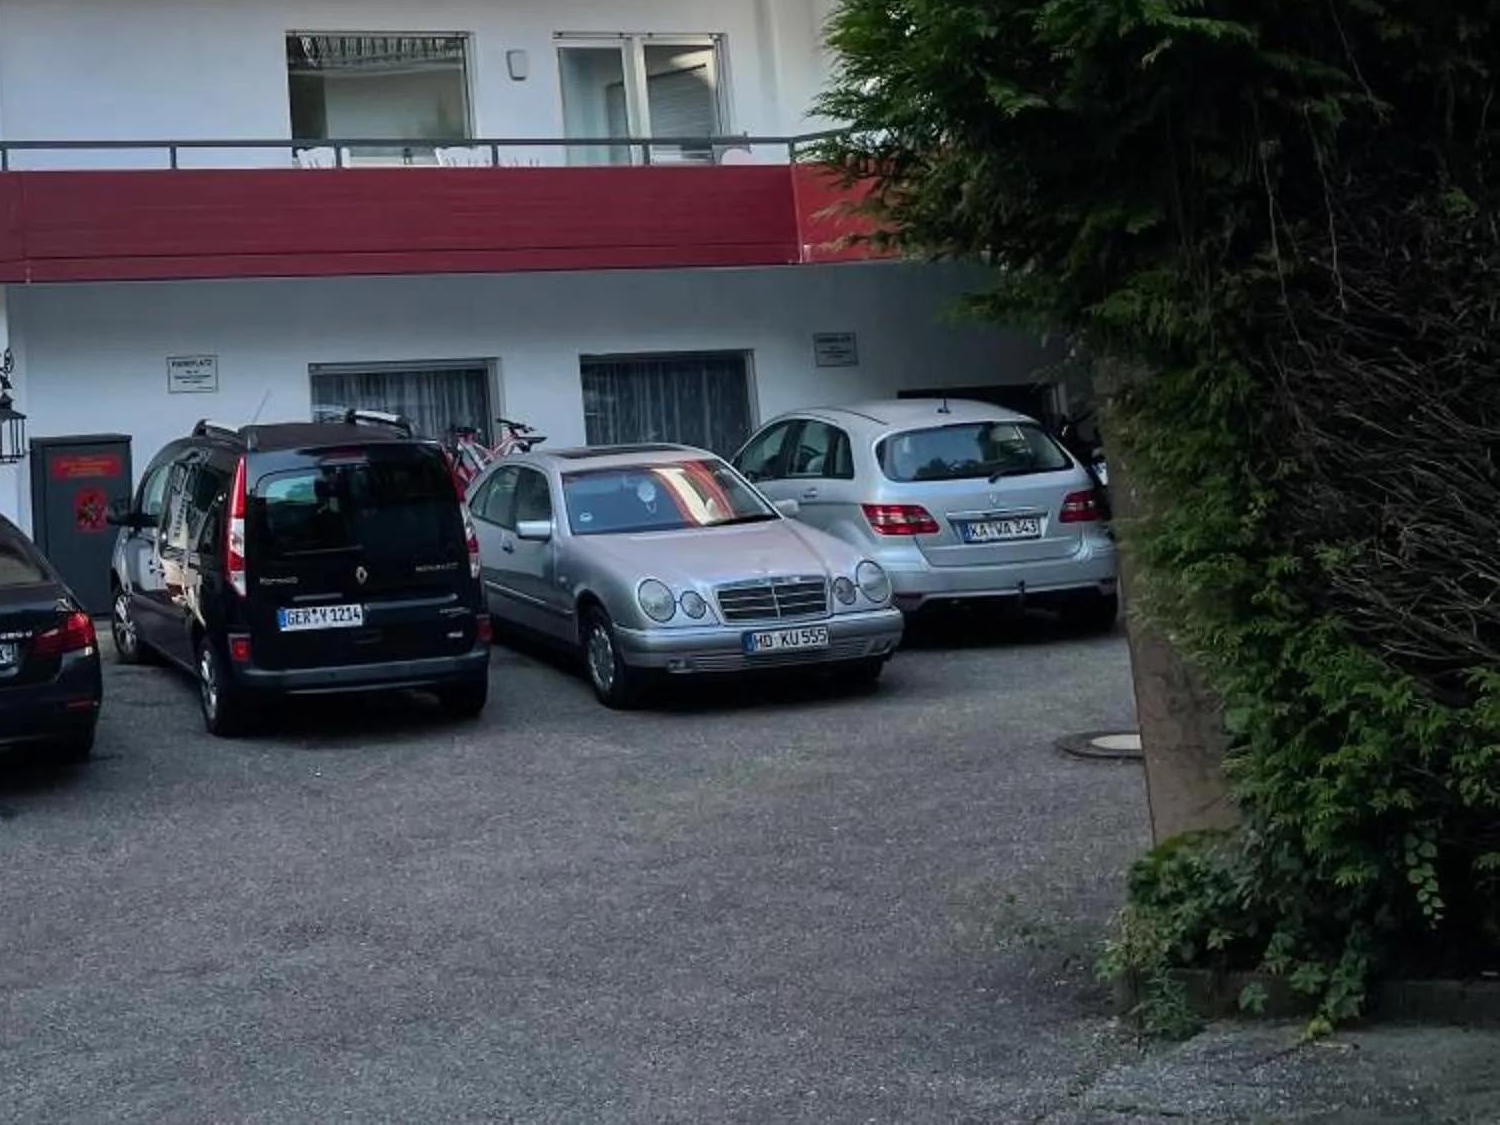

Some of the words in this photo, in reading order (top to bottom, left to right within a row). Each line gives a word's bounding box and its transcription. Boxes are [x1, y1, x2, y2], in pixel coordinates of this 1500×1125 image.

[288, 611, 311, 625] GER
[331, 606, 360, 622] 1214
[781, 631, 799, 646] KU
[801, 627, 828, 644] 555
